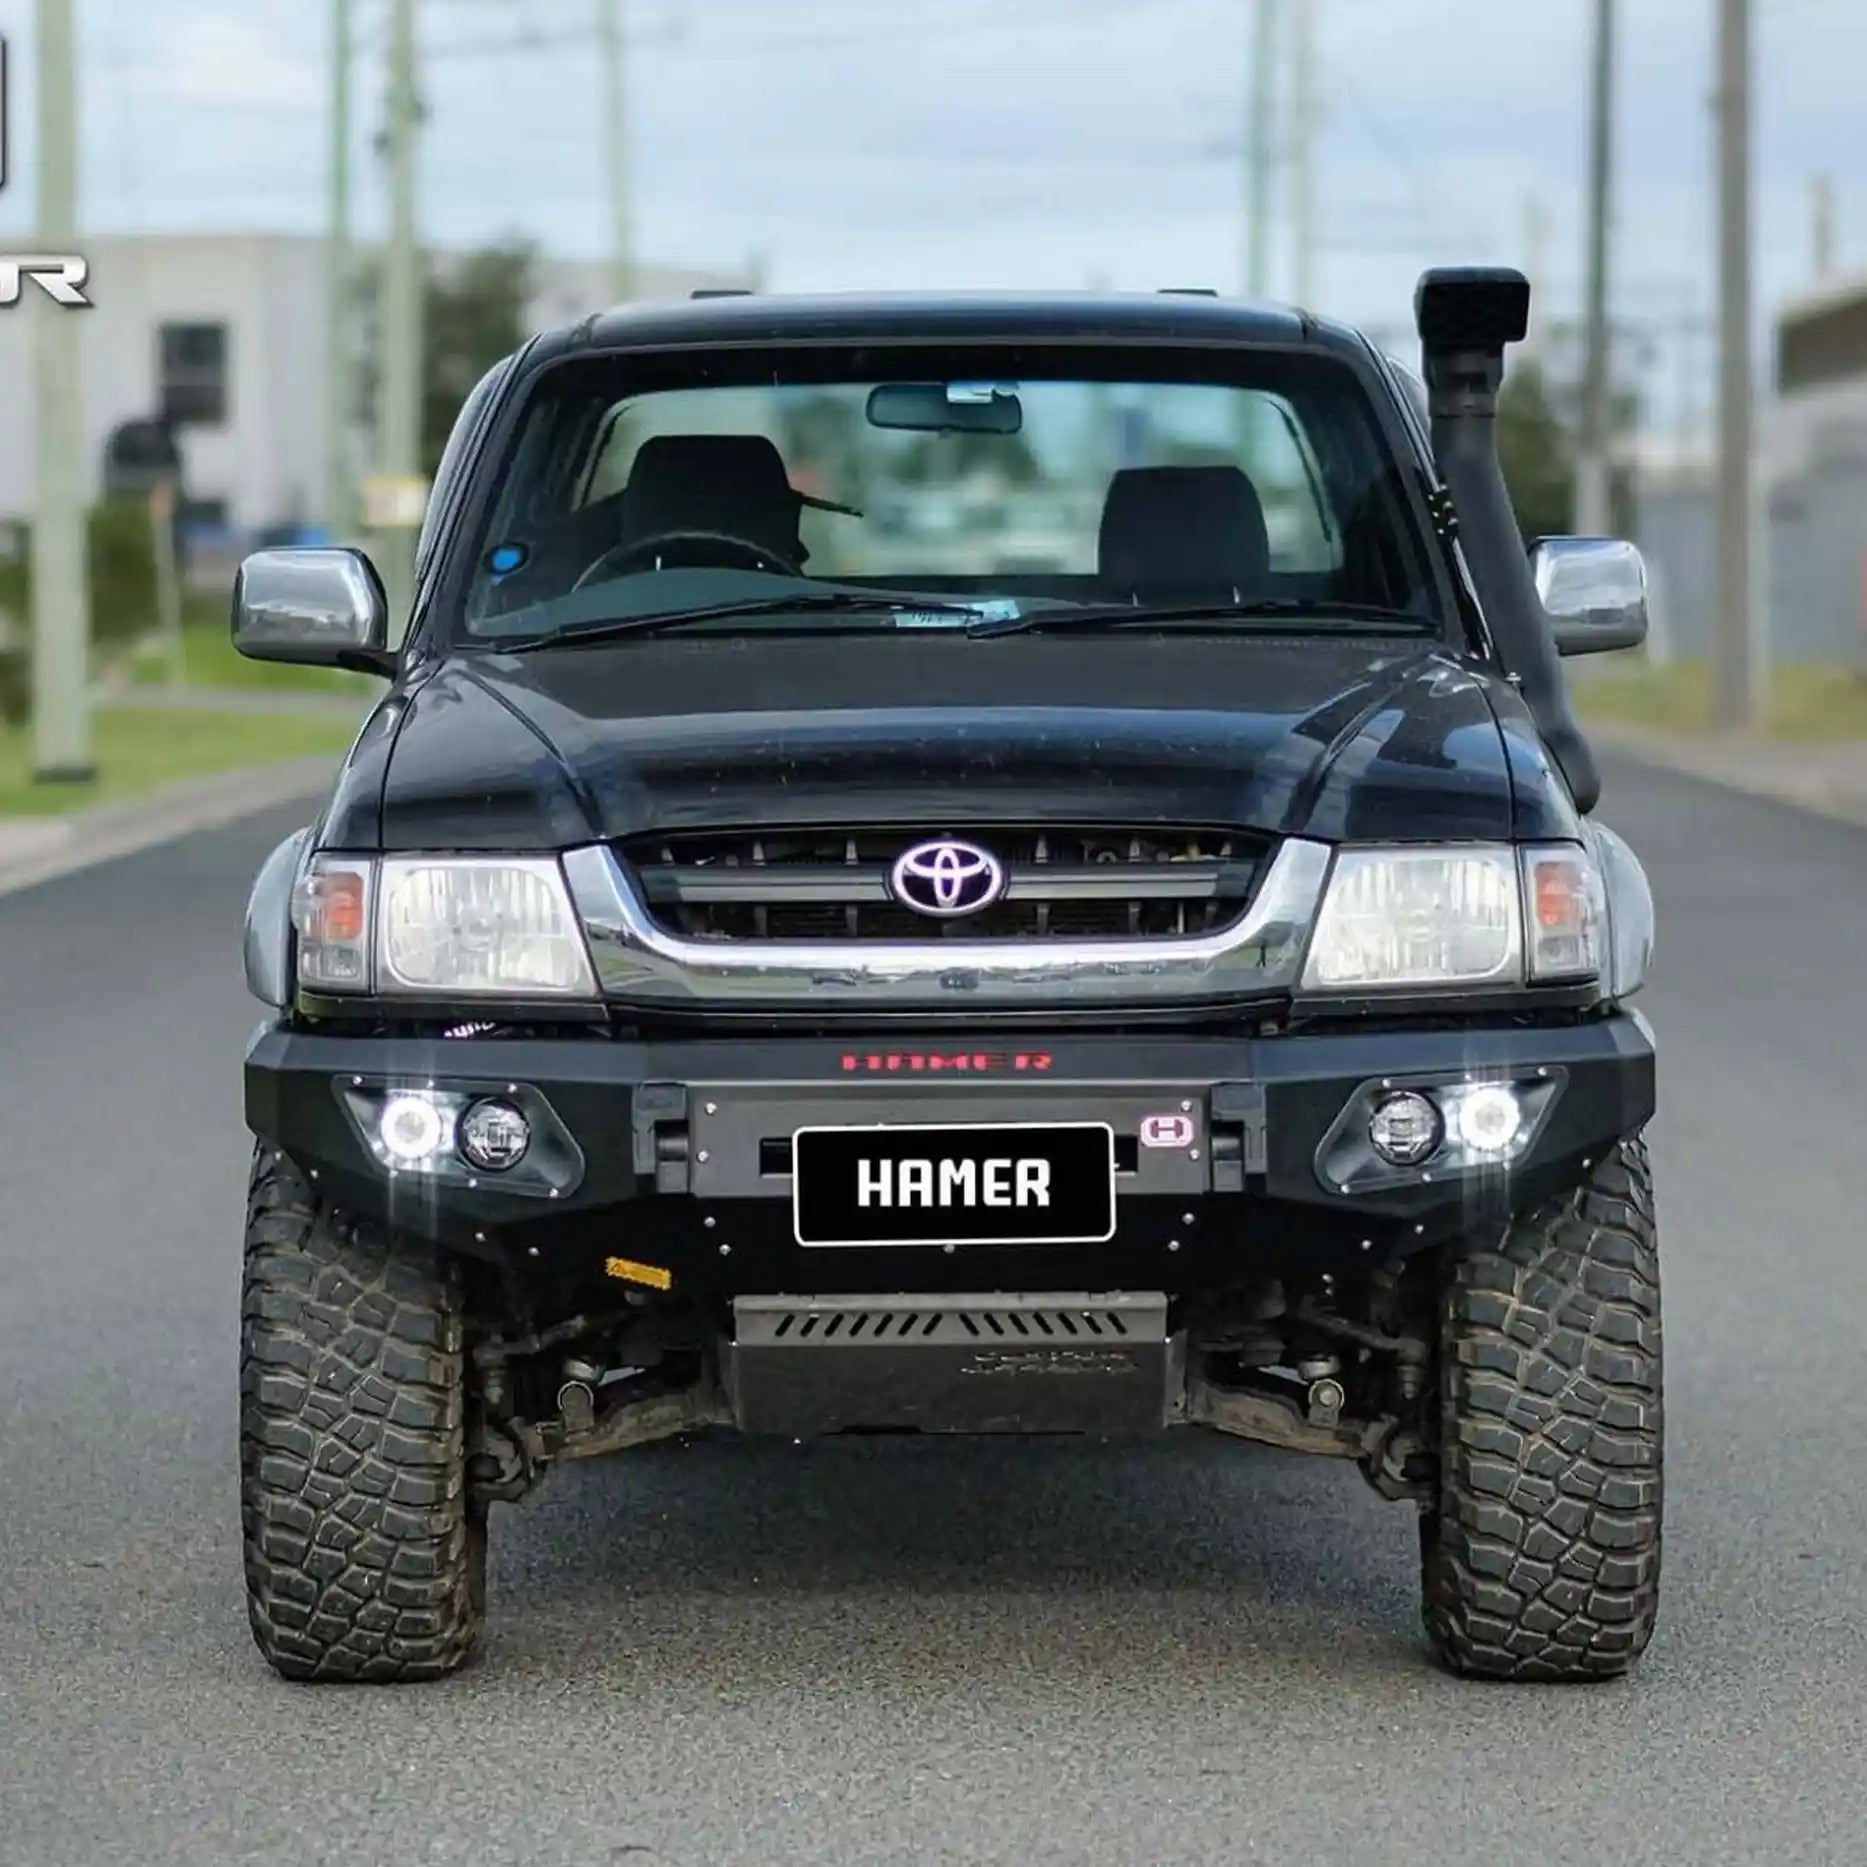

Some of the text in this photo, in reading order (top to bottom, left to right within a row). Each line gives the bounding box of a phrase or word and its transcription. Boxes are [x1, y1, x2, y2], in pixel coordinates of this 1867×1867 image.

[842, 1053, 1053, 1071] HAMER
[1150, 1119, 1184, 1139] H
[857, 1159, 1051, 1207] HAMER
